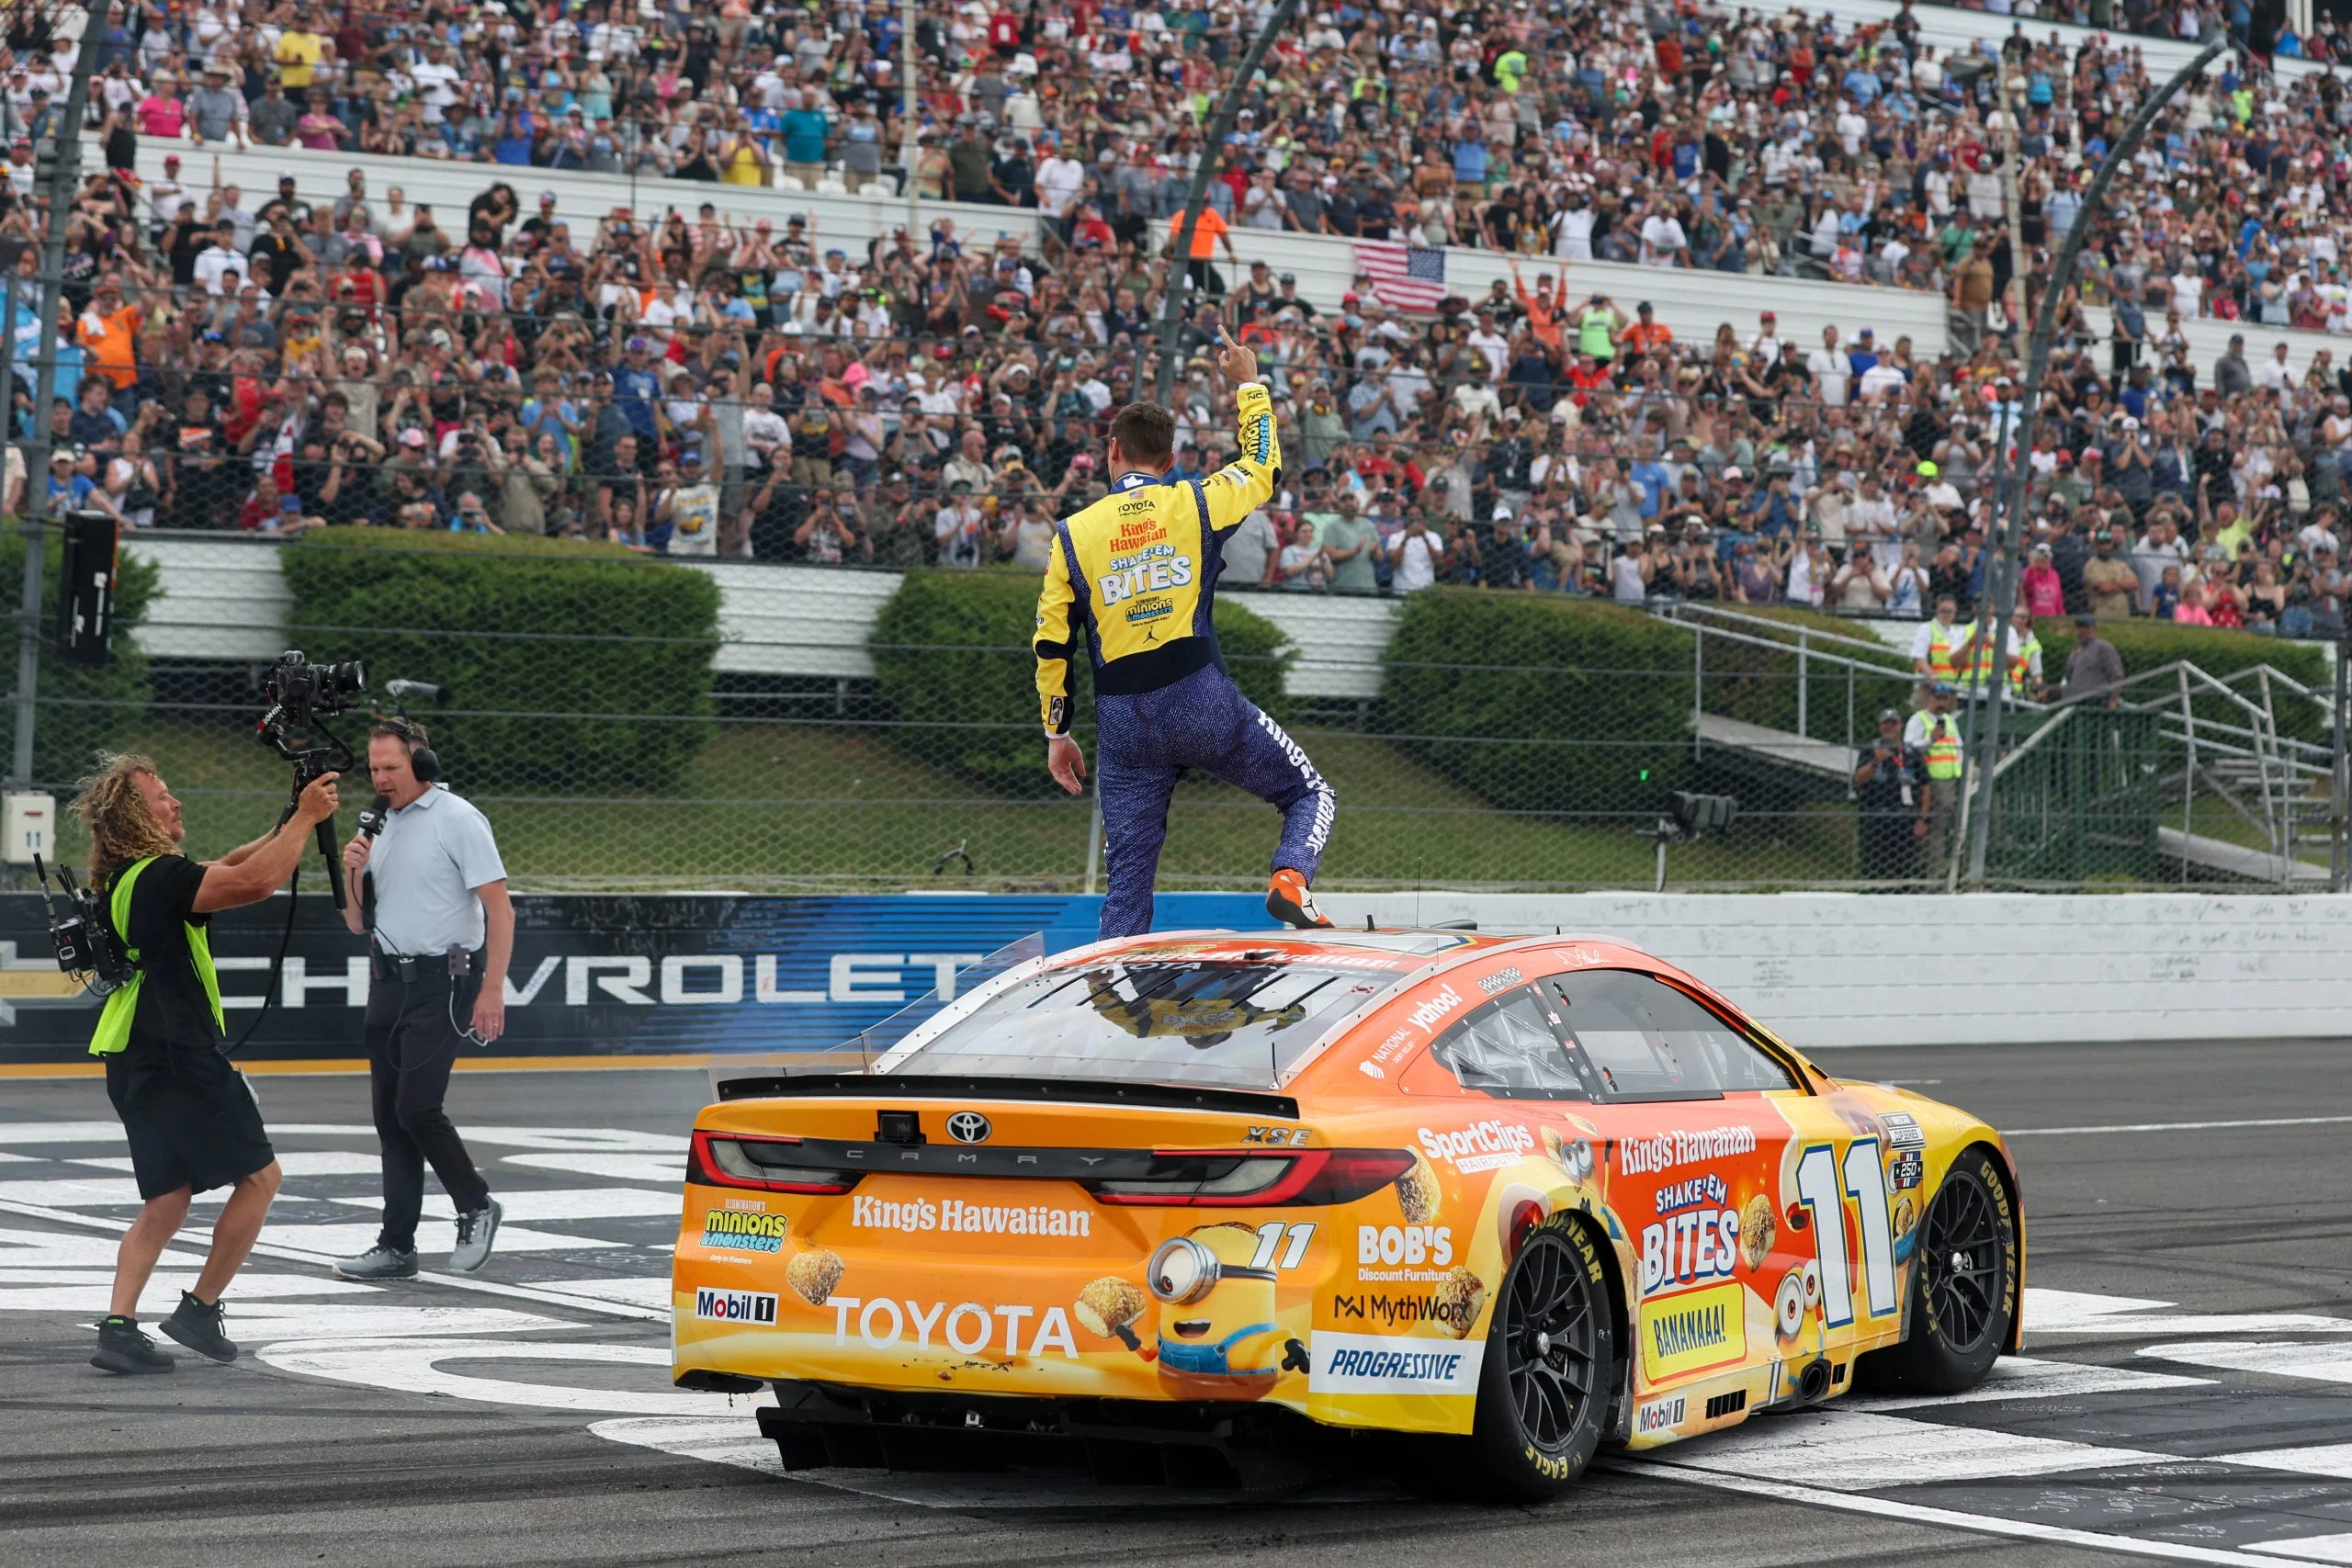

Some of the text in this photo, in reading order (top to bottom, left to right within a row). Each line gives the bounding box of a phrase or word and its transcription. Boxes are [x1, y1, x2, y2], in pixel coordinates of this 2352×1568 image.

[1117, 500, 1156, 513] TOYOTA
[1120, 518, 1157, 537] King's
[1098, 556, 1192, 605] BITES
[1408, 983, 1463, 1034] yahoo!
[1372, 1027, 1411, 1064] NATIONAL
[1241, 1126, 1312, 1146] XSE
[1620, 1125, 1756, 1176] King's Hawaiian
[1894, 1129, 1918, 1141] CUP SERIES
[846, 1149, 1103, 1166] CAMRY
[1458, 1153, 1520, 1172] HAIRCUTS
[1900, 1162, 1917, 1177] 250
[852, 1195, 1091, 1237] King's Hawaiian
[1795, 1134, 1898, 1330] 11
[710, 1254, 721, 1264] Only
[729, 1255, 752, 1265] Theaters
[1249, 1222, 1317, 1269] 11
[1358, 1225, 1453, 1266] BOB'S
[1642, 1209, 1739, 1295] BITES
[1358, 1269, 1403, 1281] Discount
[697, 1291, 752, 1320] Mobil
[1371, 1294, 1470, 1326] MythWorx
[826, 1296, 1079, 1359] TOYOTA
[1654, 1303, 1726, 1359] BANANAAA!
[1329, 1348, 1462, 1380] PROGRESSIVE
[1639, 1404, 1672, 1433] Mobil
[1524, 1441, 1568, 1479] EAGLE
